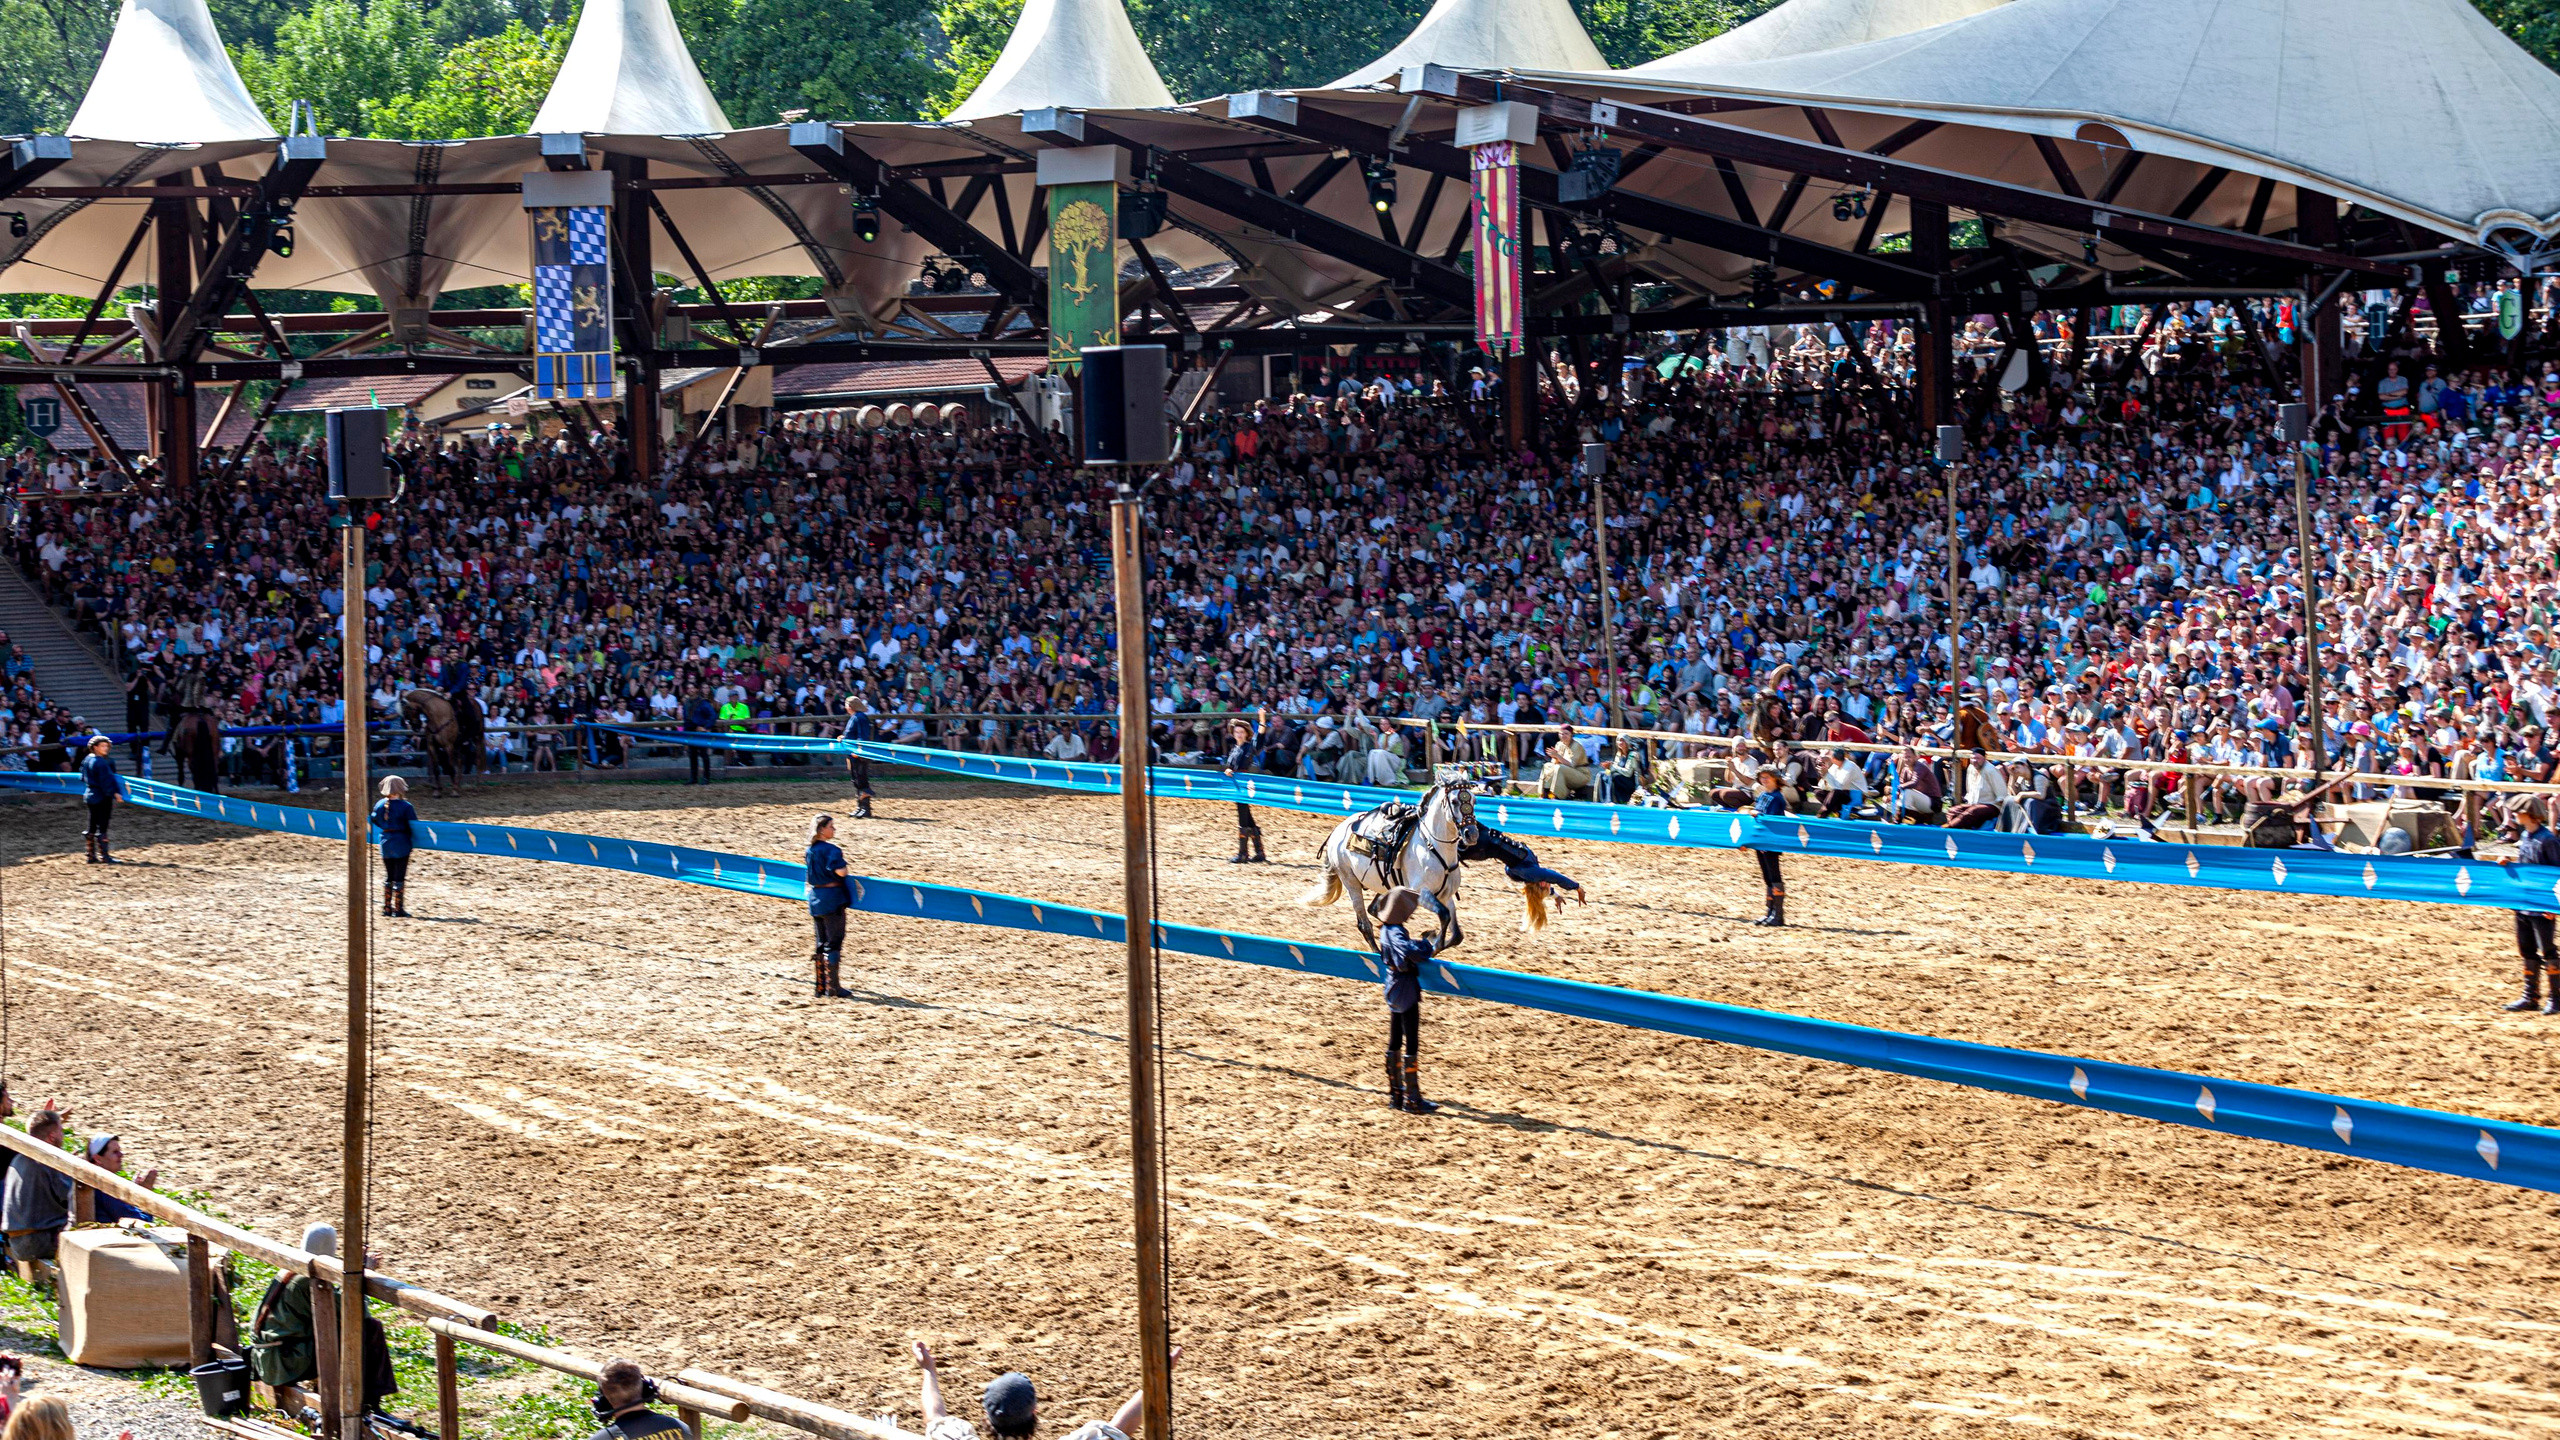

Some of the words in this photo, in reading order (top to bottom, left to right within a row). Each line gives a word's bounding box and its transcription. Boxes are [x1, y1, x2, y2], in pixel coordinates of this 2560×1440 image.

[2369, 310, 2386, 338] H
[2500, 297, 2519, 329] G
[29, 402, 57, 427] H
